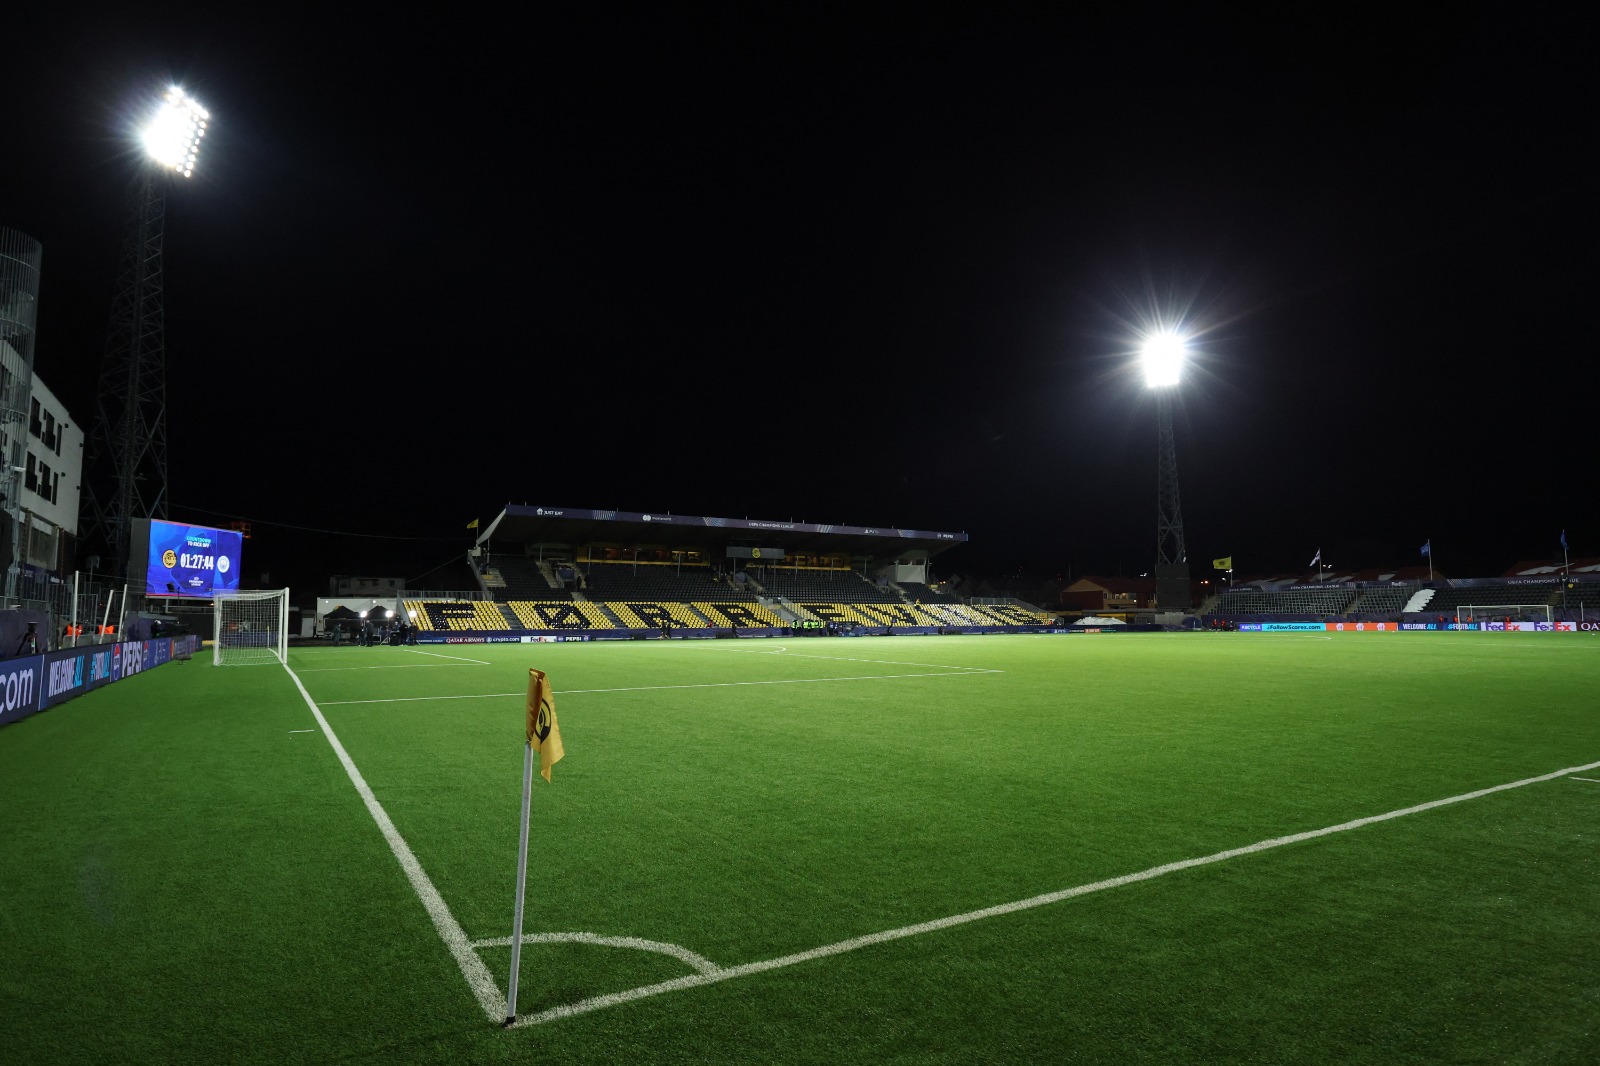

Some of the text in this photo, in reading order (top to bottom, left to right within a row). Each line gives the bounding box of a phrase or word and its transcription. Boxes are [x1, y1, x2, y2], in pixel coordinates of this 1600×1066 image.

[180, 553, 214, 570] 01:27:44
[1486, 621, 1519, 631] FedEx
[122, 641, 142, 678] PEPSI
[49, 656, 85, 697] WELCOME ALL
